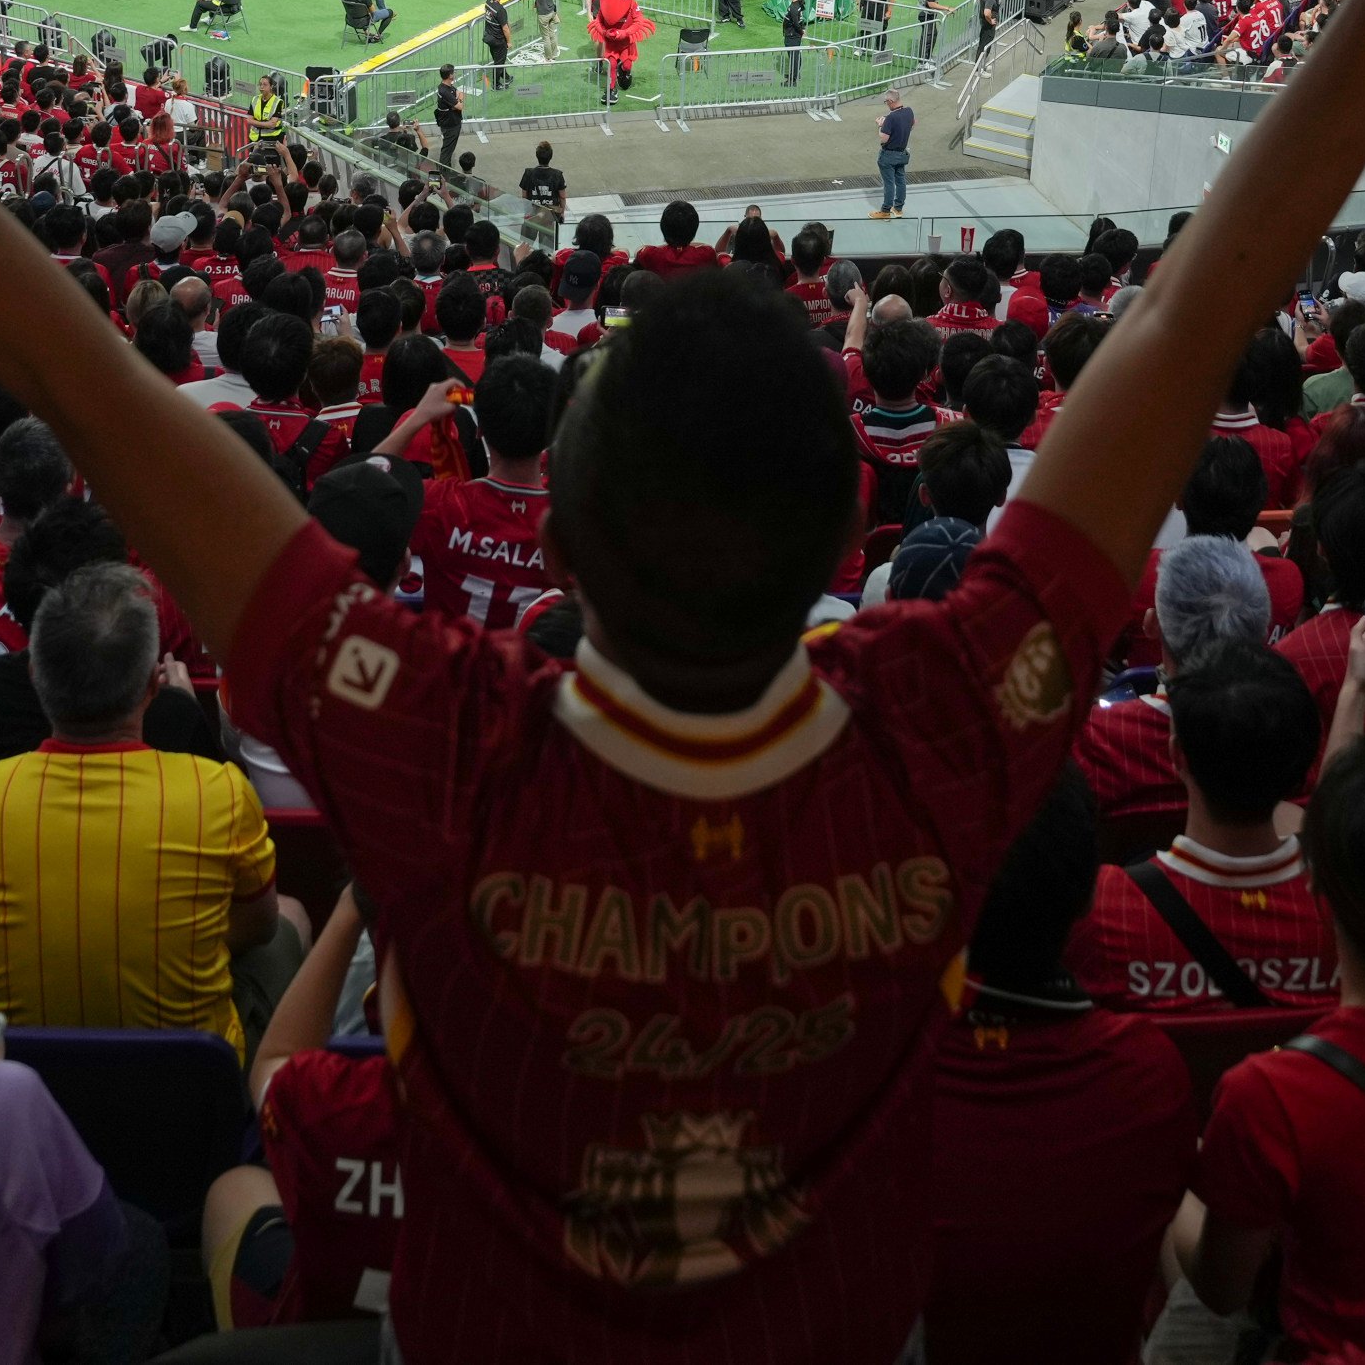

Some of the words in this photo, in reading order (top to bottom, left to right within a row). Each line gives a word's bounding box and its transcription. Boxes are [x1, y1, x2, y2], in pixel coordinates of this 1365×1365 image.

[204, 265, 240, 274] O.S.RA
[325, 288, 355, 301] ARWIN
[448, 527, 545, 570] M.SALA
[1128, 955, 1340, 999] SZOOSZLA
[562, 996, 857, 1079] 24/25
[333, 1156, 406, 1217] ZH
